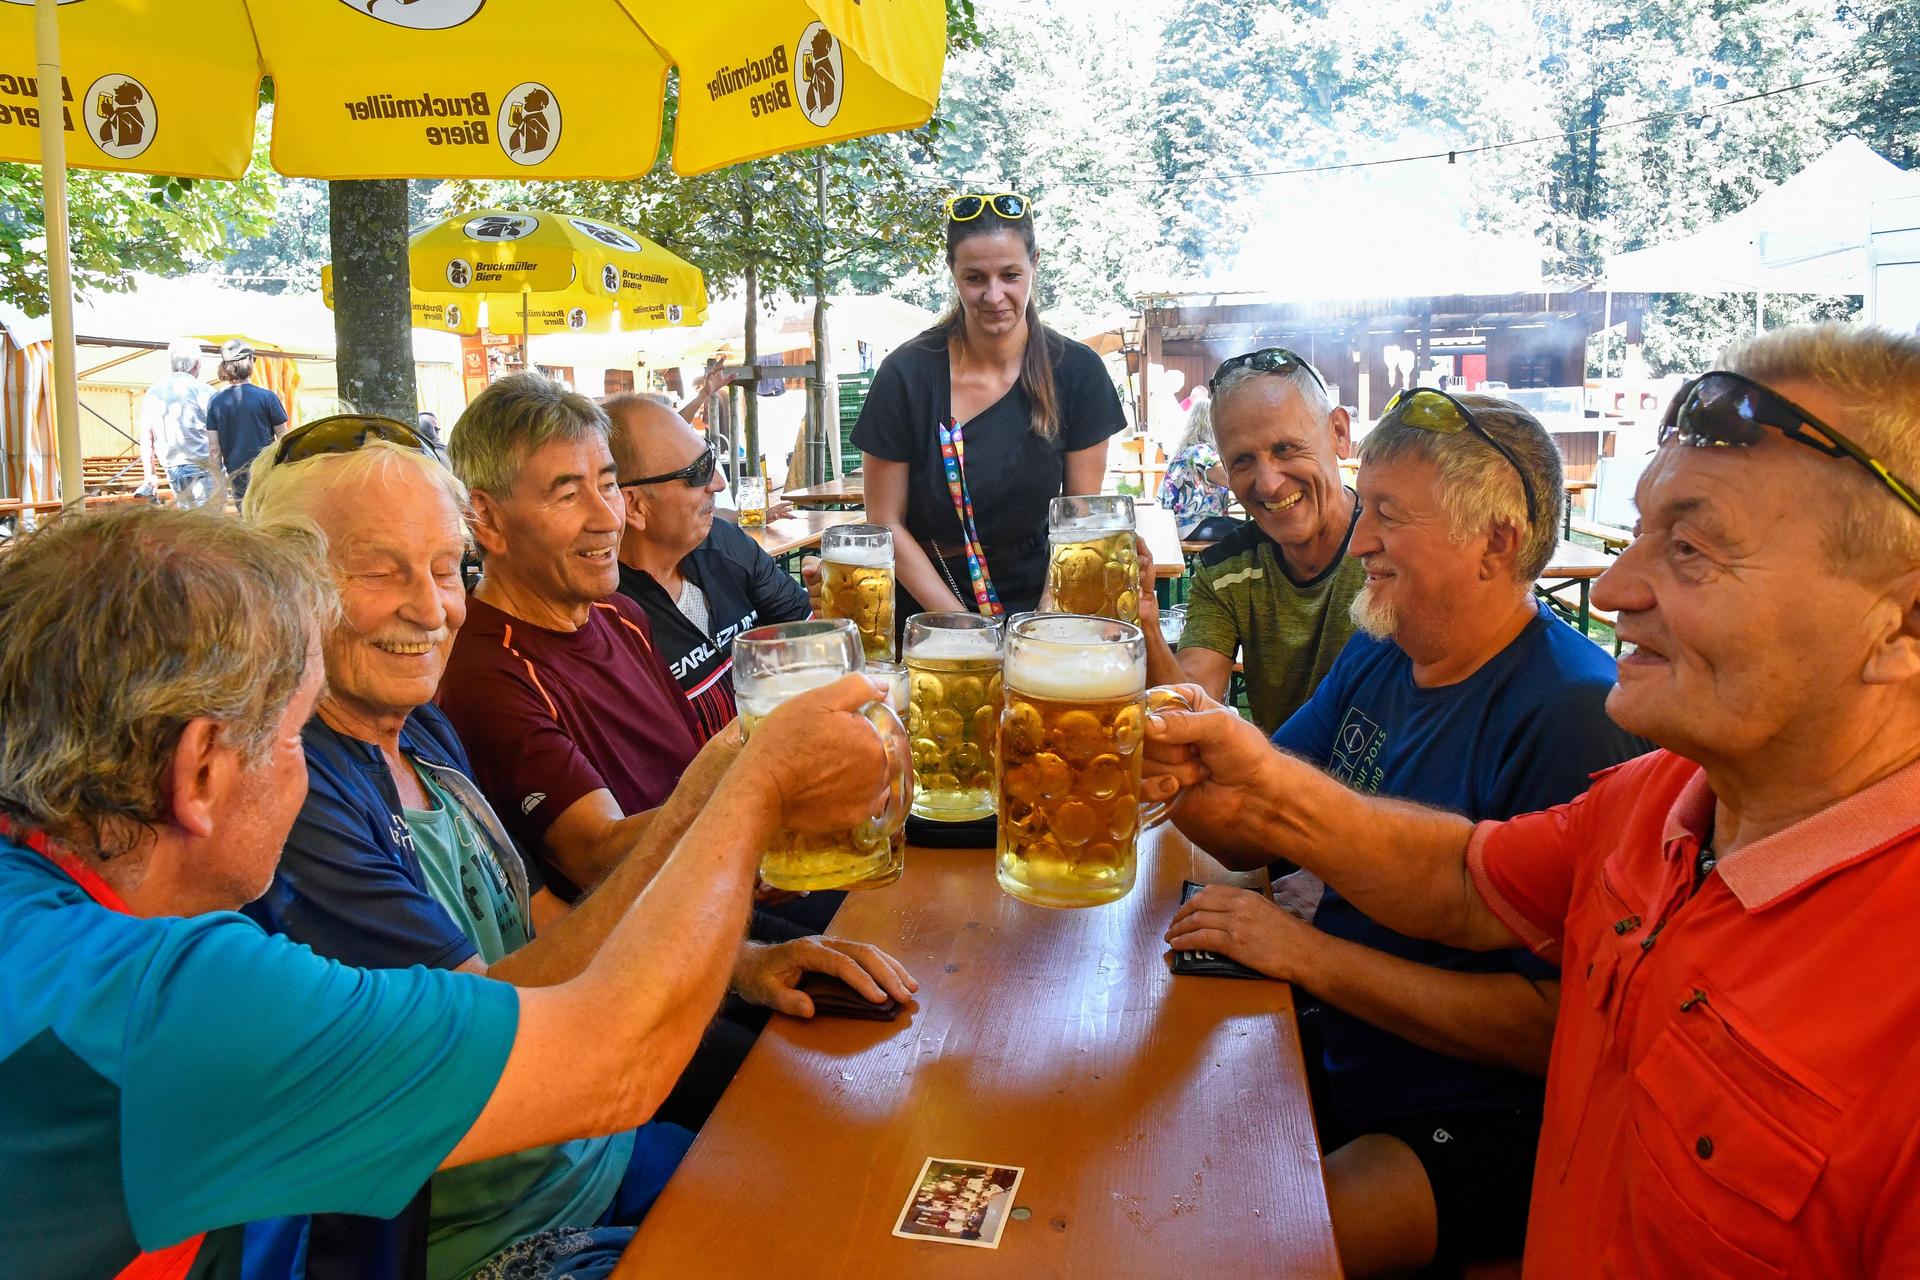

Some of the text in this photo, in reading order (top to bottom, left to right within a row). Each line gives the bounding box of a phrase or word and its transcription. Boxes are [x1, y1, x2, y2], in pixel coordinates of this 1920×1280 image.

[475, 261, 538, 272] Bruckmüller
[475, 272, 502, 282] Biere
[622, 269, 669, 285] Bruckmüller
[622, 279, 642, 290] Biere
[669, 642, 717, 680] EARL
[1352, 730, 1387, 790] our 2015
[1368, 766, 1384, 794] ung
